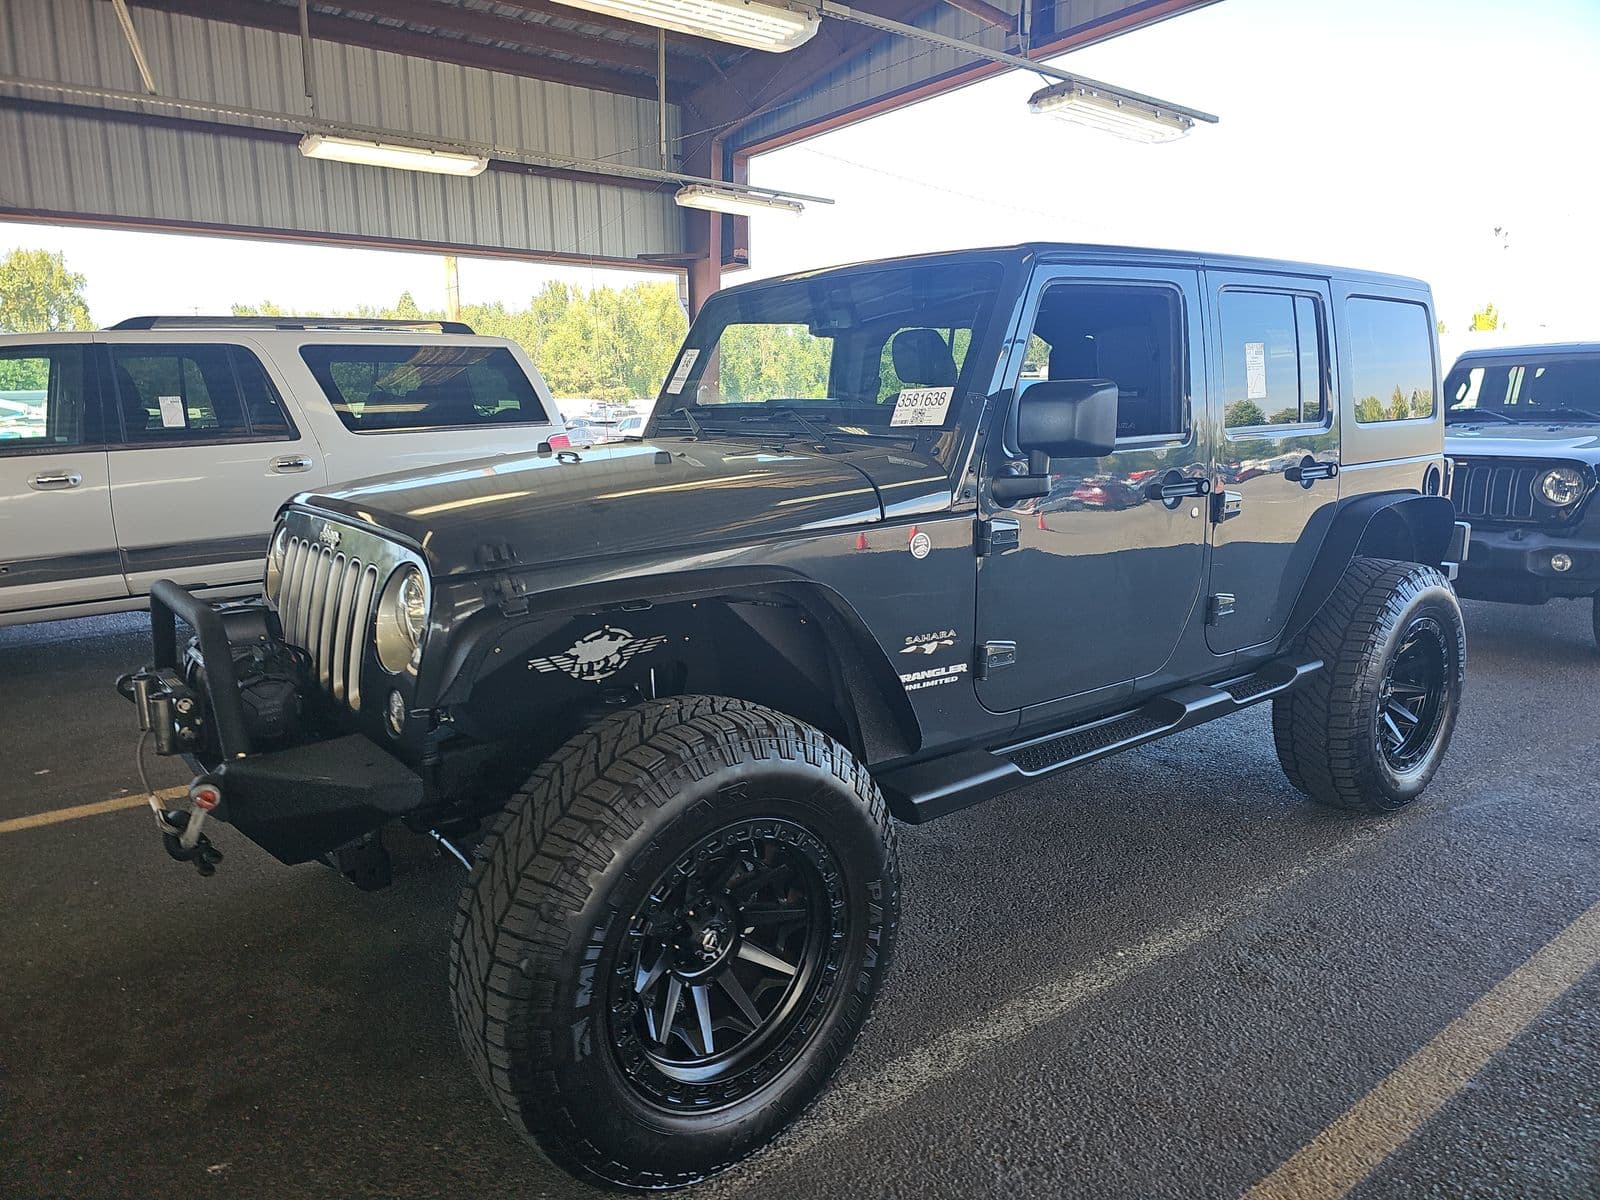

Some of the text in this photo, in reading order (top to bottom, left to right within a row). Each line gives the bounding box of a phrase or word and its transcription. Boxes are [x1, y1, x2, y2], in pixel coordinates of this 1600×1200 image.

[898, 391, 947, 408] 3581638
[905, 629, 957, 645] SAHARA
[899, 663, 968, 683] RANGLER
